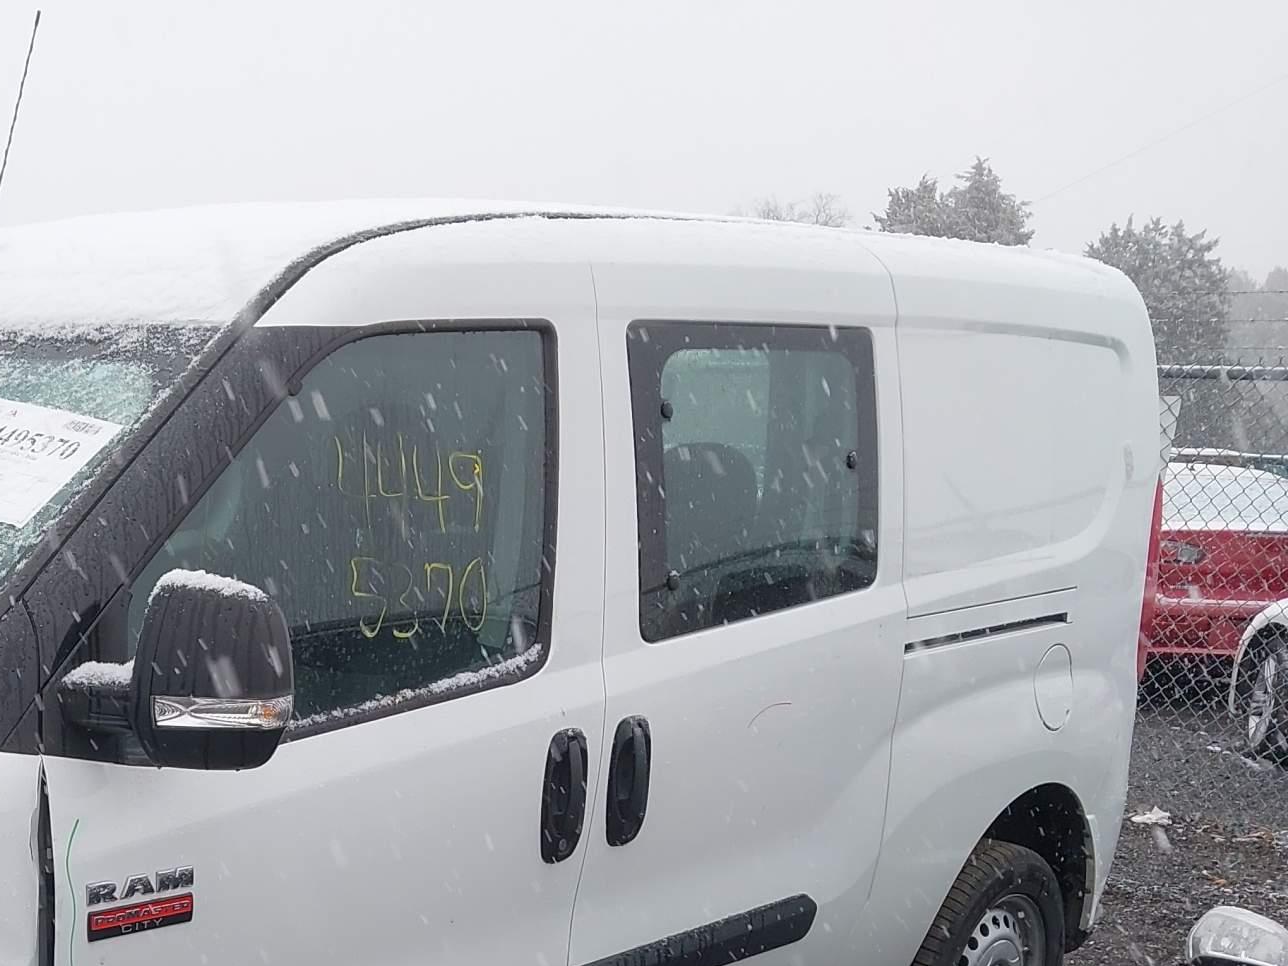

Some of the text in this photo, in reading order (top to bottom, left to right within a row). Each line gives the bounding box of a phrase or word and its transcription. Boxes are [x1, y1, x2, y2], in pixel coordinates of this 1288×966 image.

[334, 432, 485, 540] 4449
[350, 557, 488, 638] 5370
[86, 865, 194, 906] RAM
[120, 918, 163, 935] CITY
